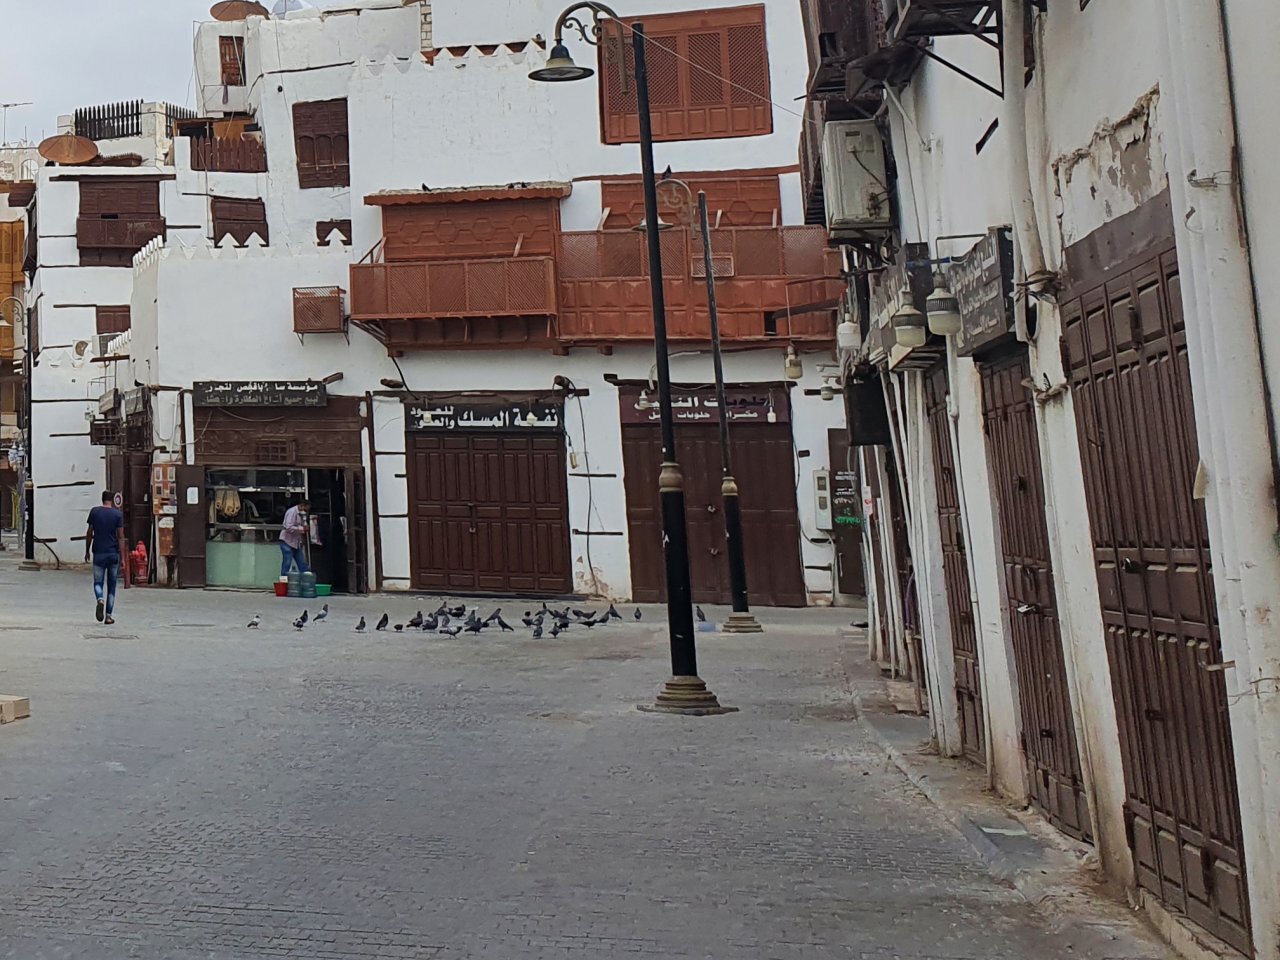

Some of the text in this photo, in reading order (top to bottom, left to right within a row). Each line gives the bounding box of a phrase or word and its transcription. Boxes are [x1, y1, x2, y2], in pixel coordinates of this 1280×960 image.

[287, 382, 318, 393] مؤسسة
[457, 407, 559, 428] نفة المسك
[677, 410, 711, 420] حلويات
